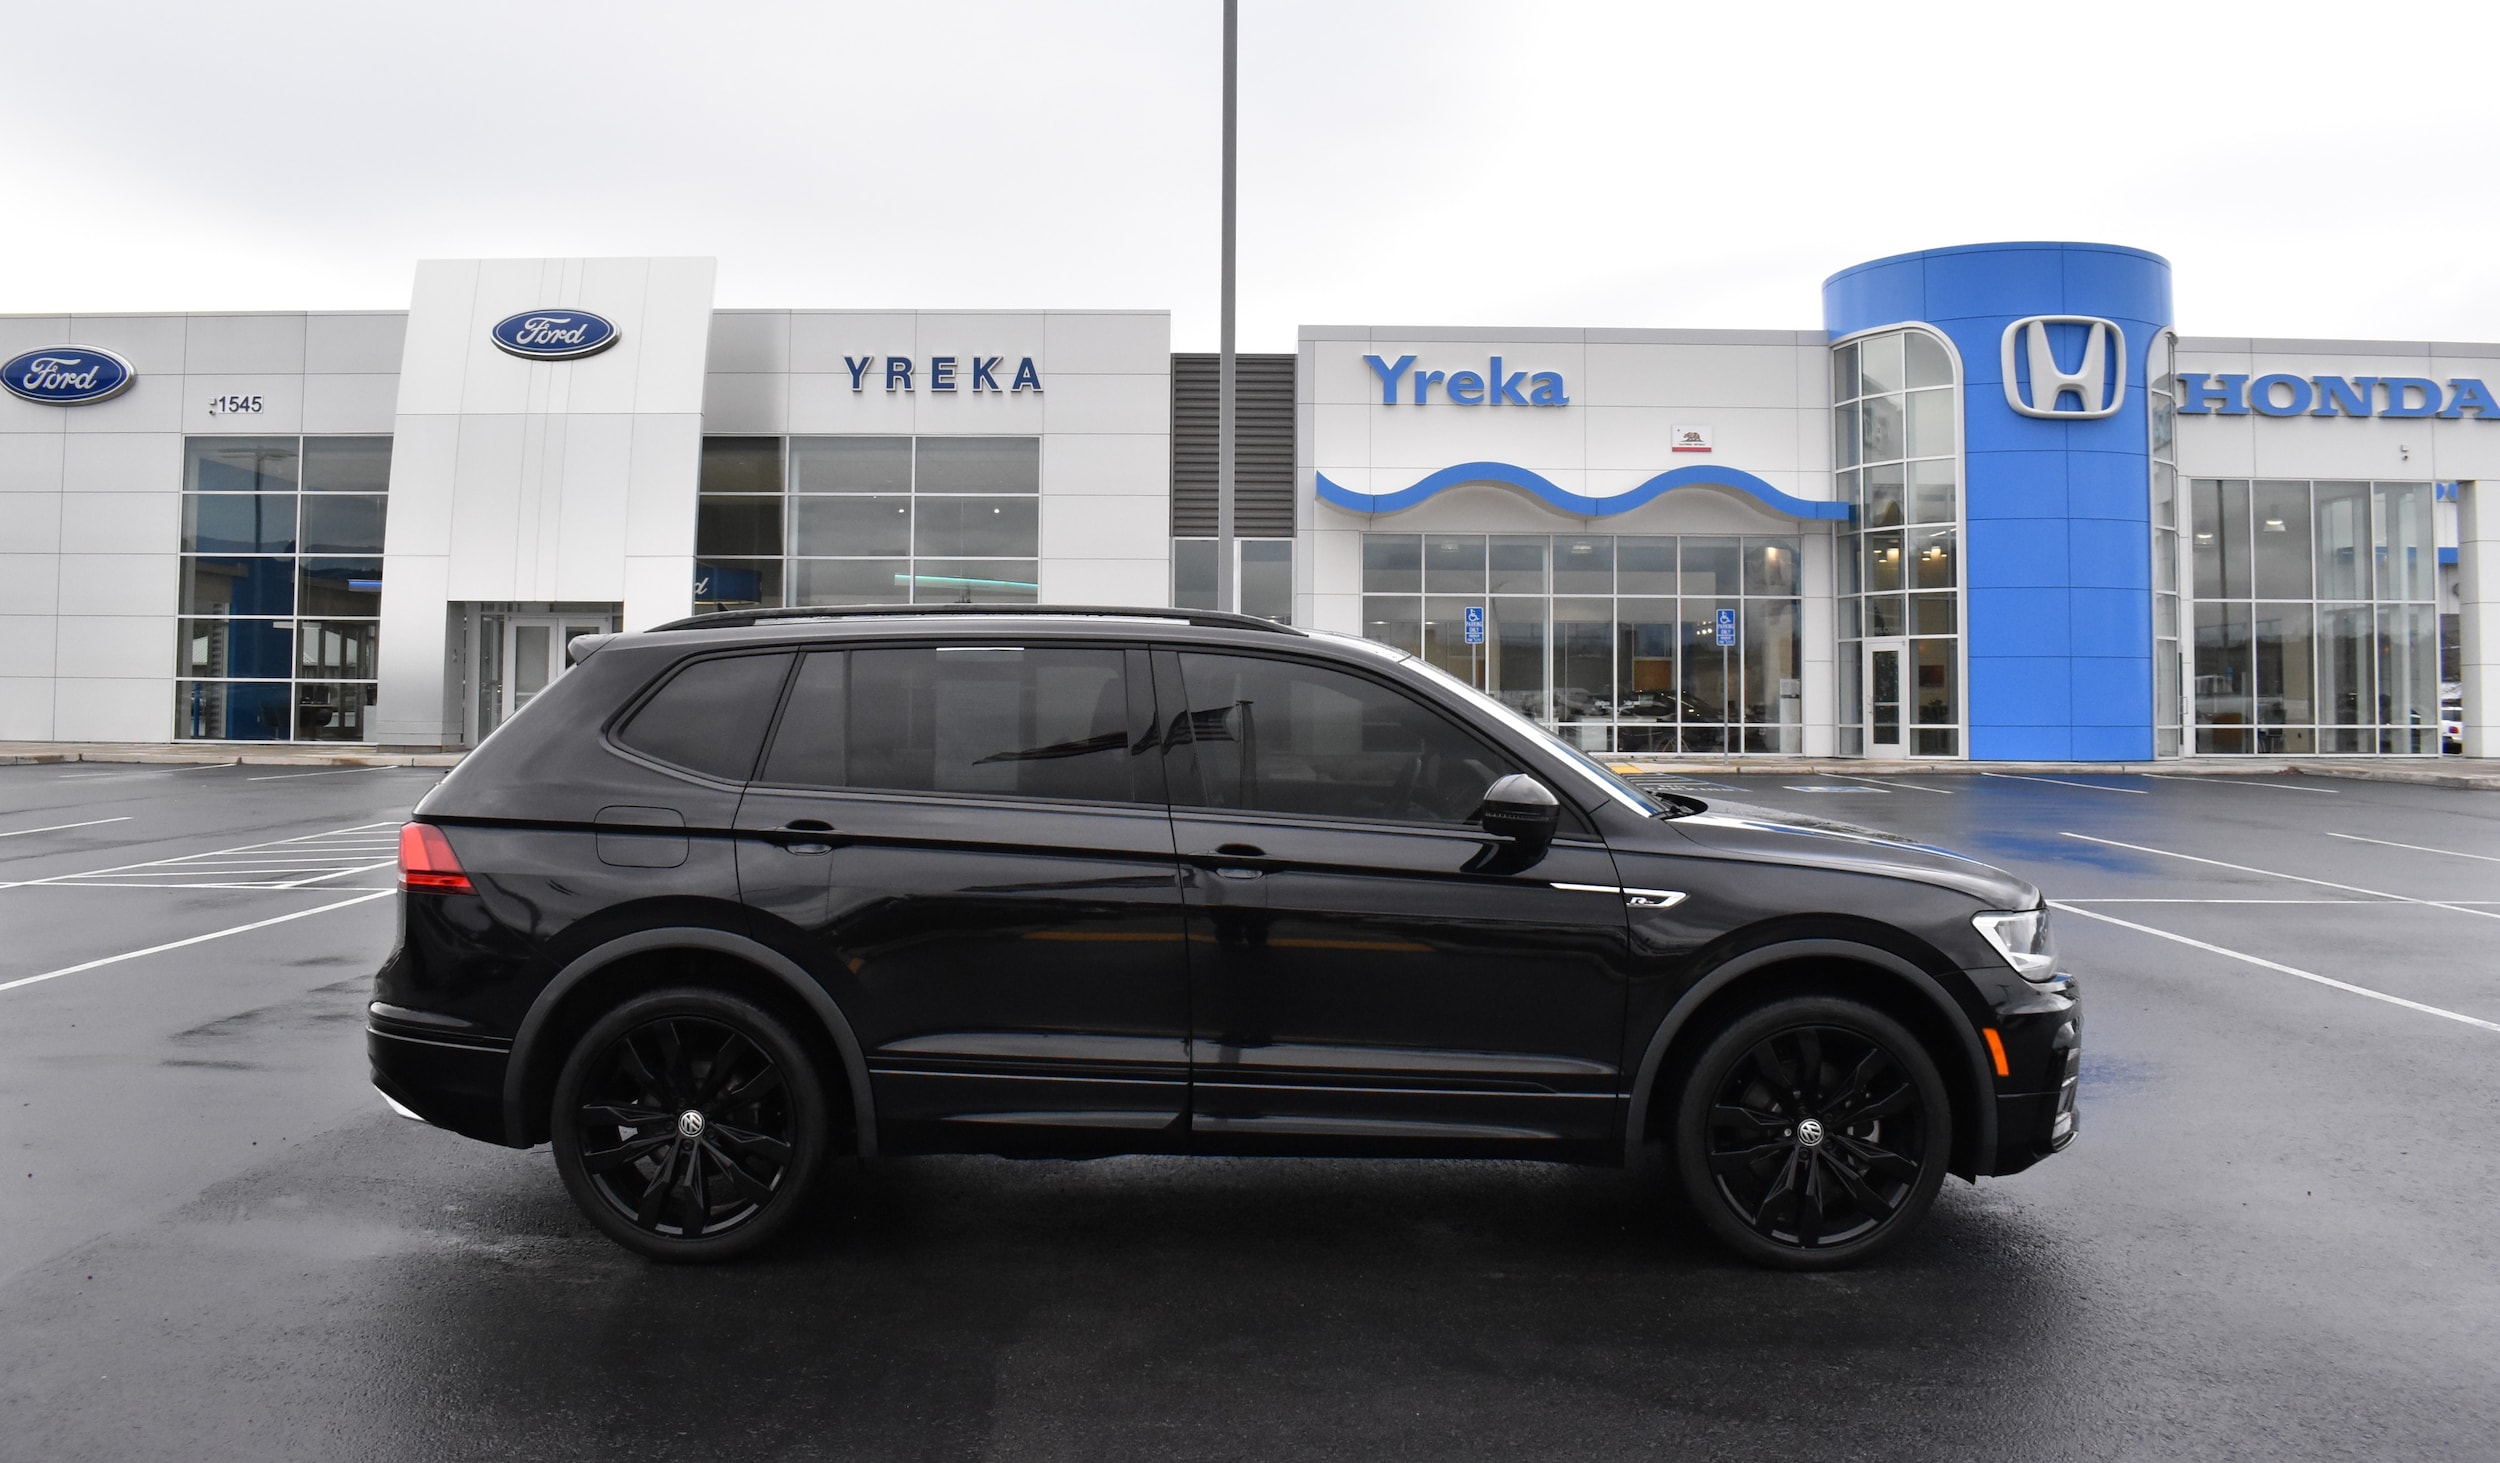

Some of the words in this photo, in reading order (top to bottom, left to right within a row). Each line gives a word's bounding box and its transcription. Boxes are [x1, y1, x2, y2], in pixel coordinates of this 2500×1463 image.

[515, 317, 588, 345] Ford
[23, 357, 100, 390] Ford
[844, 354, 1044, 392] YREKA
[1363, 354, 1570, 407] Yreka
[218, 395, 262, 413] 1545
[2176, 372, 2500, 419] HONDA
